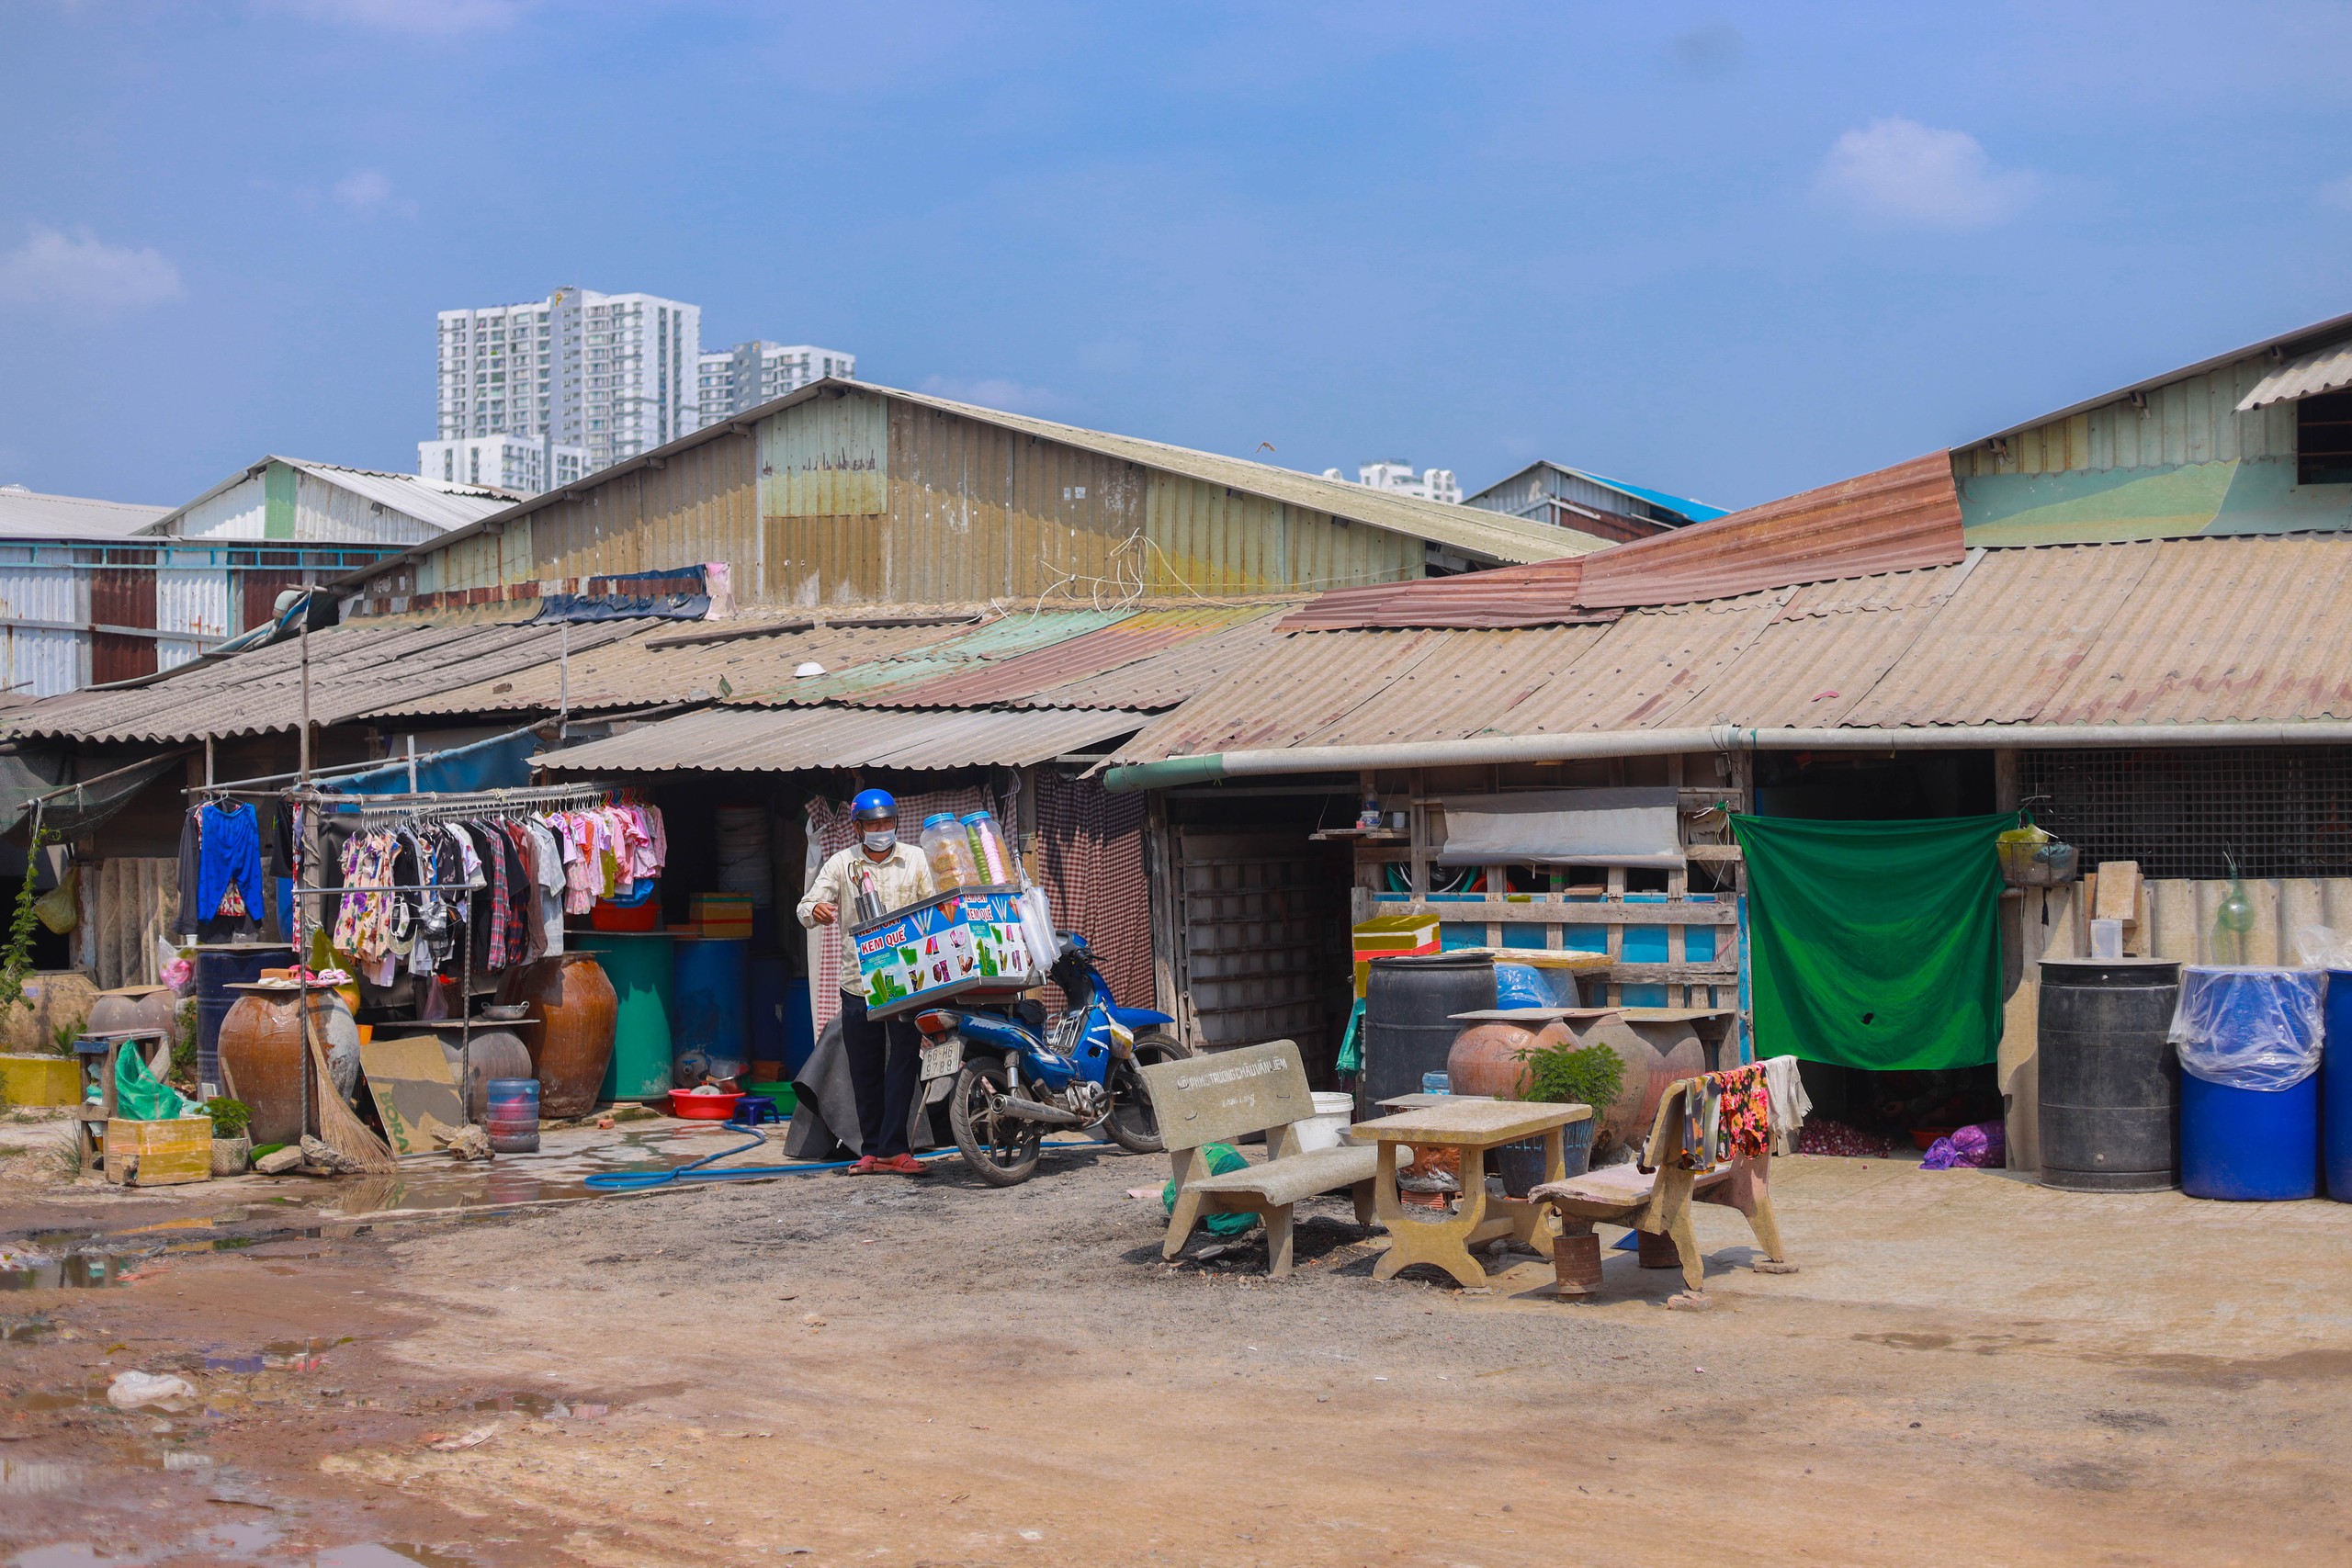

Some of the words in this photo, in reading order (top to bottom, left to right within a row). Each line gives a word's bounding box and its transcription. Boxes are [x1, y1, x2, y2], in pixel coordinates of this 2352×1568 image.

[967, 908, 979, 919] KEM
[980, 905, 993, 921] QUẾ
[861, 937, 883, 954] KEM
[886, 924, 906, 946] QUẾ
